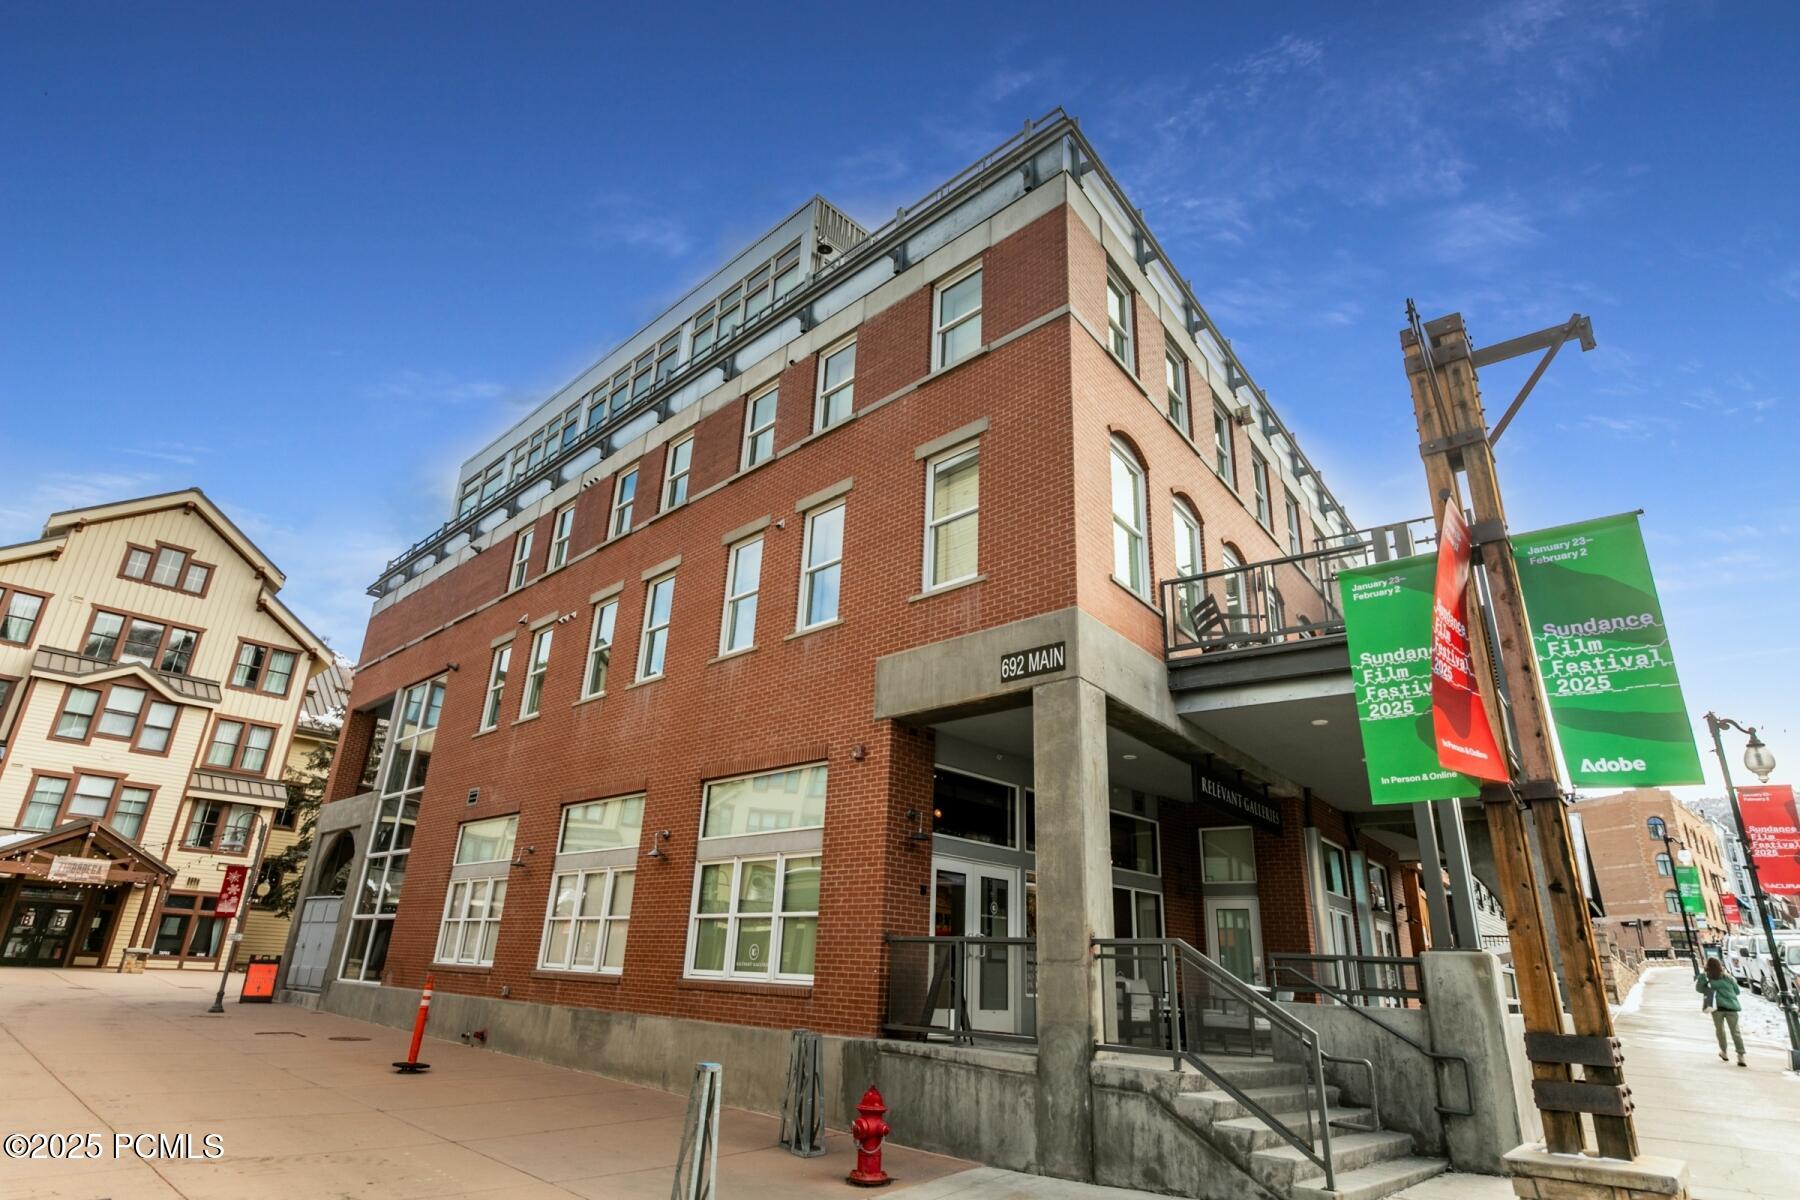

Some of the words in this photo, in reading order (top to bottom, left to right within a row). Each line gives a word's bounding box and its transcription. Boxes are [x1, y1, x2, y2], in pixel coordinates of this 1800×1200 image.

[1528, 541, 1570, 555] January
[1530, 551, 1578, 565] February
[1579, 547, 1588, 557] 2
[1352, 580, 1387, 592] January
[1353, 588, 1393, 601] February
[1393, 585, 1401, 593] 2
[1543, 612, 1654, 638] Sundance
[1360, 647, 1432, 666] Sundan
[1548, 639, 1603, 657] Film
[1001, 655, 1025, 678] 692
[1028, 645, 1064, 673] MAIN
[1552, 648, 1660, 675] Festival
[1363, 666, 1409, 684] Film
[1366, 680, 1432, 699] Festiv
[1556, 675, 1612, 695] 2025
[1369, 699, 1415, 720] 2025
[1580, 757, 1647, 773] Adobe
[1381, 776, 1390, 785] In
[1390, 775, 1421, 784] Person
[1421, 773, 1429, 781] &
[1429, 770, 1458, 781] Online
[1201, 776, 1243, 808] RELEVANT
[1243, 797, 1280, 825] GALLERIES
[1748, 825, 1798, 834] Sundance
[1750, 833, 1776, 841] Film
[1752, 840, 1800, 850] Festival
[1754, 848, 1779, 858] 2025
